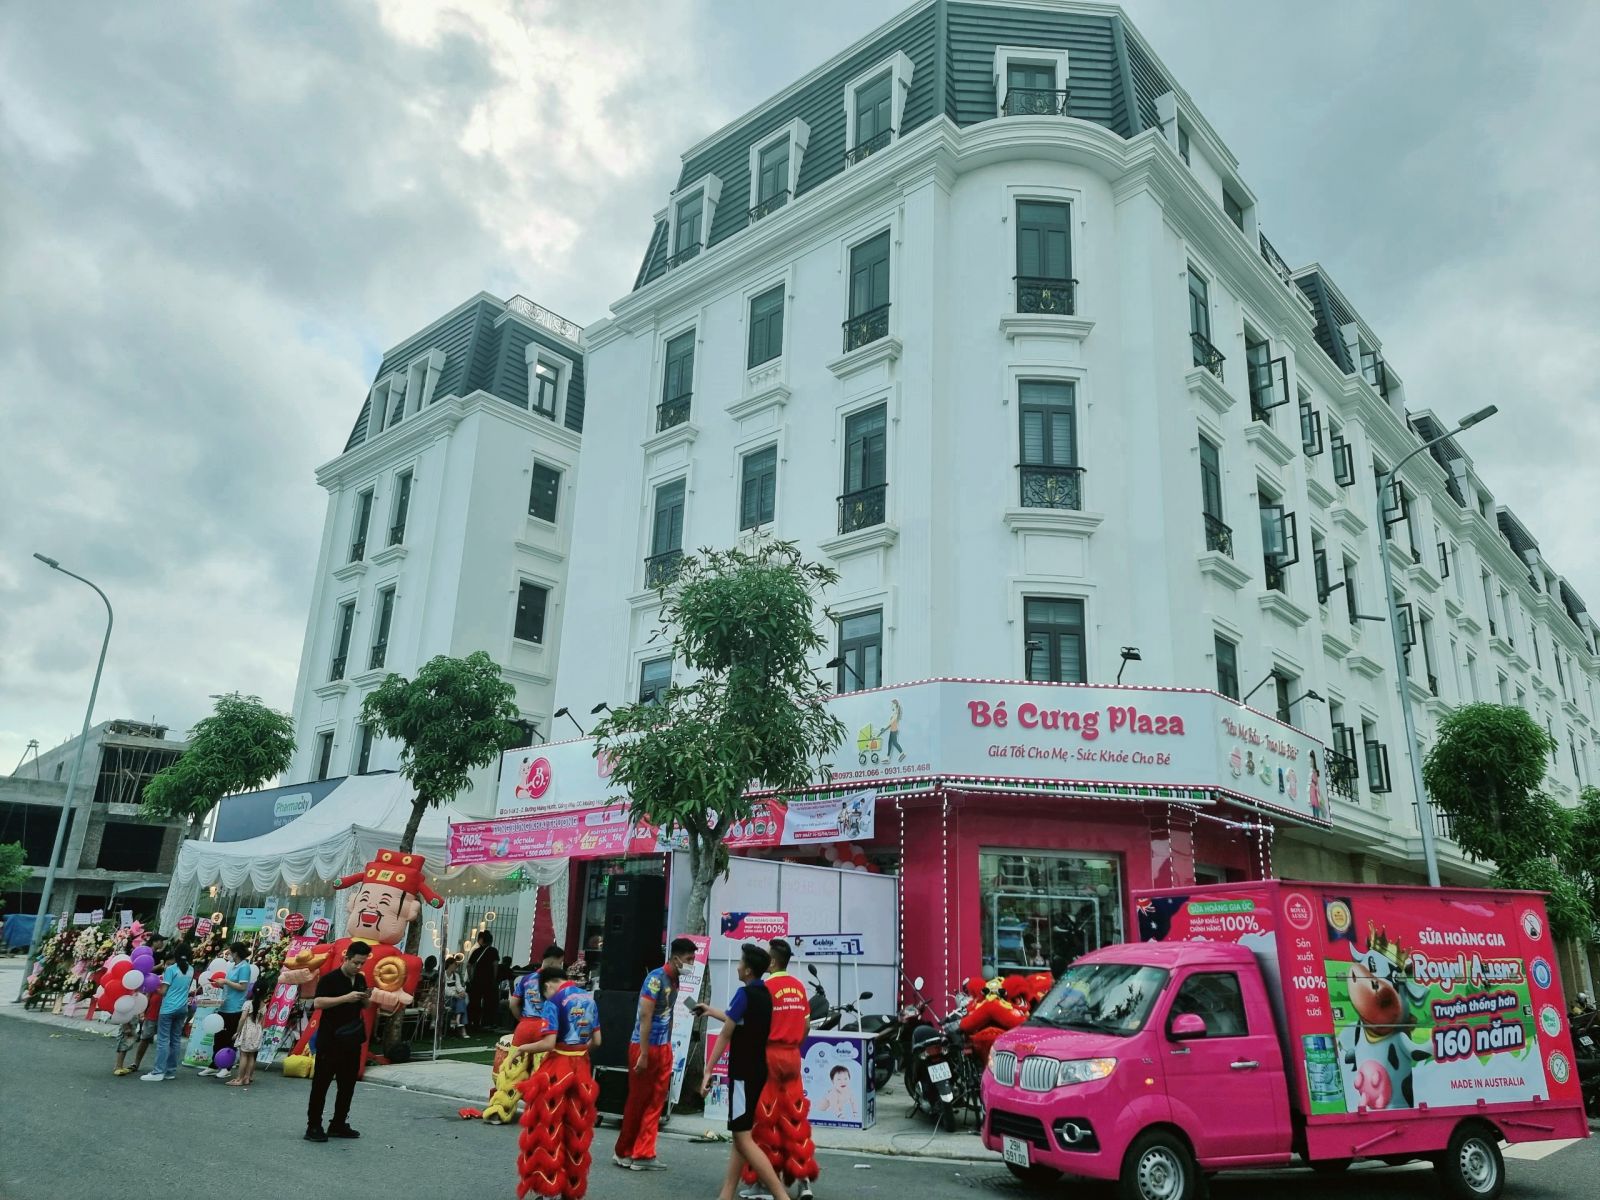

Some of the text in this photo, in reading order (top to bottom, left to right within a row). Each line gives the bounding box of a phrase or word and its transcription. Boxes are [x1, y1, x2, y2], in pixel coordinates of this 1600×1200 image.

[967, 701, 1008, 728] Bé
[1107, 705, 1185, 736] Plaza
[988, 745, 1007, 758] Giá
[1010, 744, 1026, 758] Tốt
[1027, 746, 1050, 760] Cho
[1052, 748, 1069, 763] Mẹ
[1076, 748, 1098, 762] Sức
[1131, 753, 1155, 766] Cho
[1156, 754, 1171, 766] Bé
[460, 833, 482, 847] 100%
[1229, 902, 1242, 912] GIA
[763, 925, 785, 934] 100%
[1220, 915, 1259, 932] 100%
[1296, 937, 1311, 948] Sản
[1419, 926, 1506, 947] SỮA HOÀNG GIA
[1297, 950, 1314, 961] xuất
[1411, 952, 1465, 990] Royal
[1292, 974, 1327, 989] 100%
[1434, 994, 1516, 1018] Truyền thống hơn
[1435, 1019, 1523, 1058] 160 năm
[1450, 1076, 1526, 1089] MADE IN AUSTRALIA
